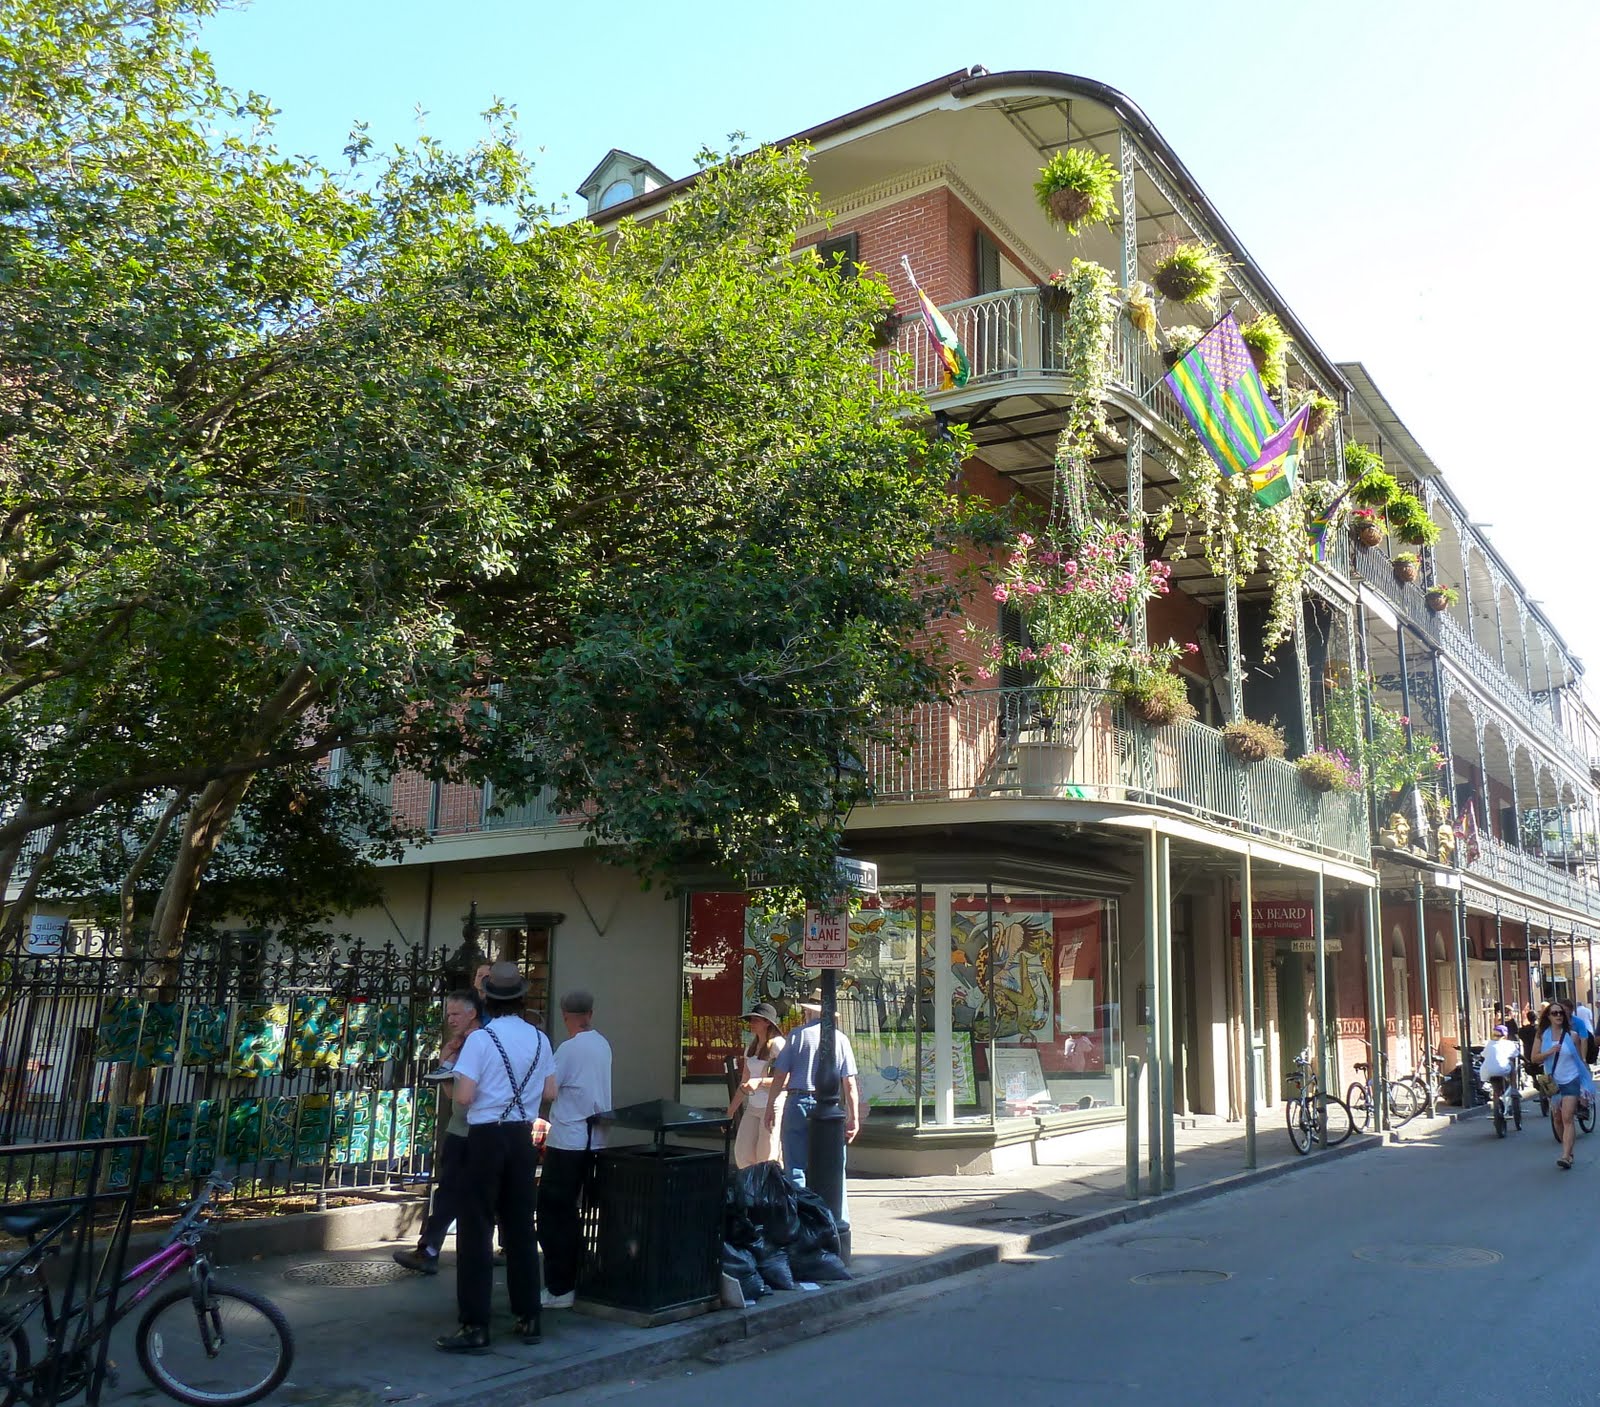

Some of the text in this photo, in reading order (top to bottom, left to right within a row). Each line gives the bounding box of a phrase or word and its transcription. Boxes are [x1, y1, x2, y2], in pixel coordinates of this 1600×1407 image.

[814, 913, 839, 925] FIRE
[1234, 907, 1306, 919] AEX BEARD
